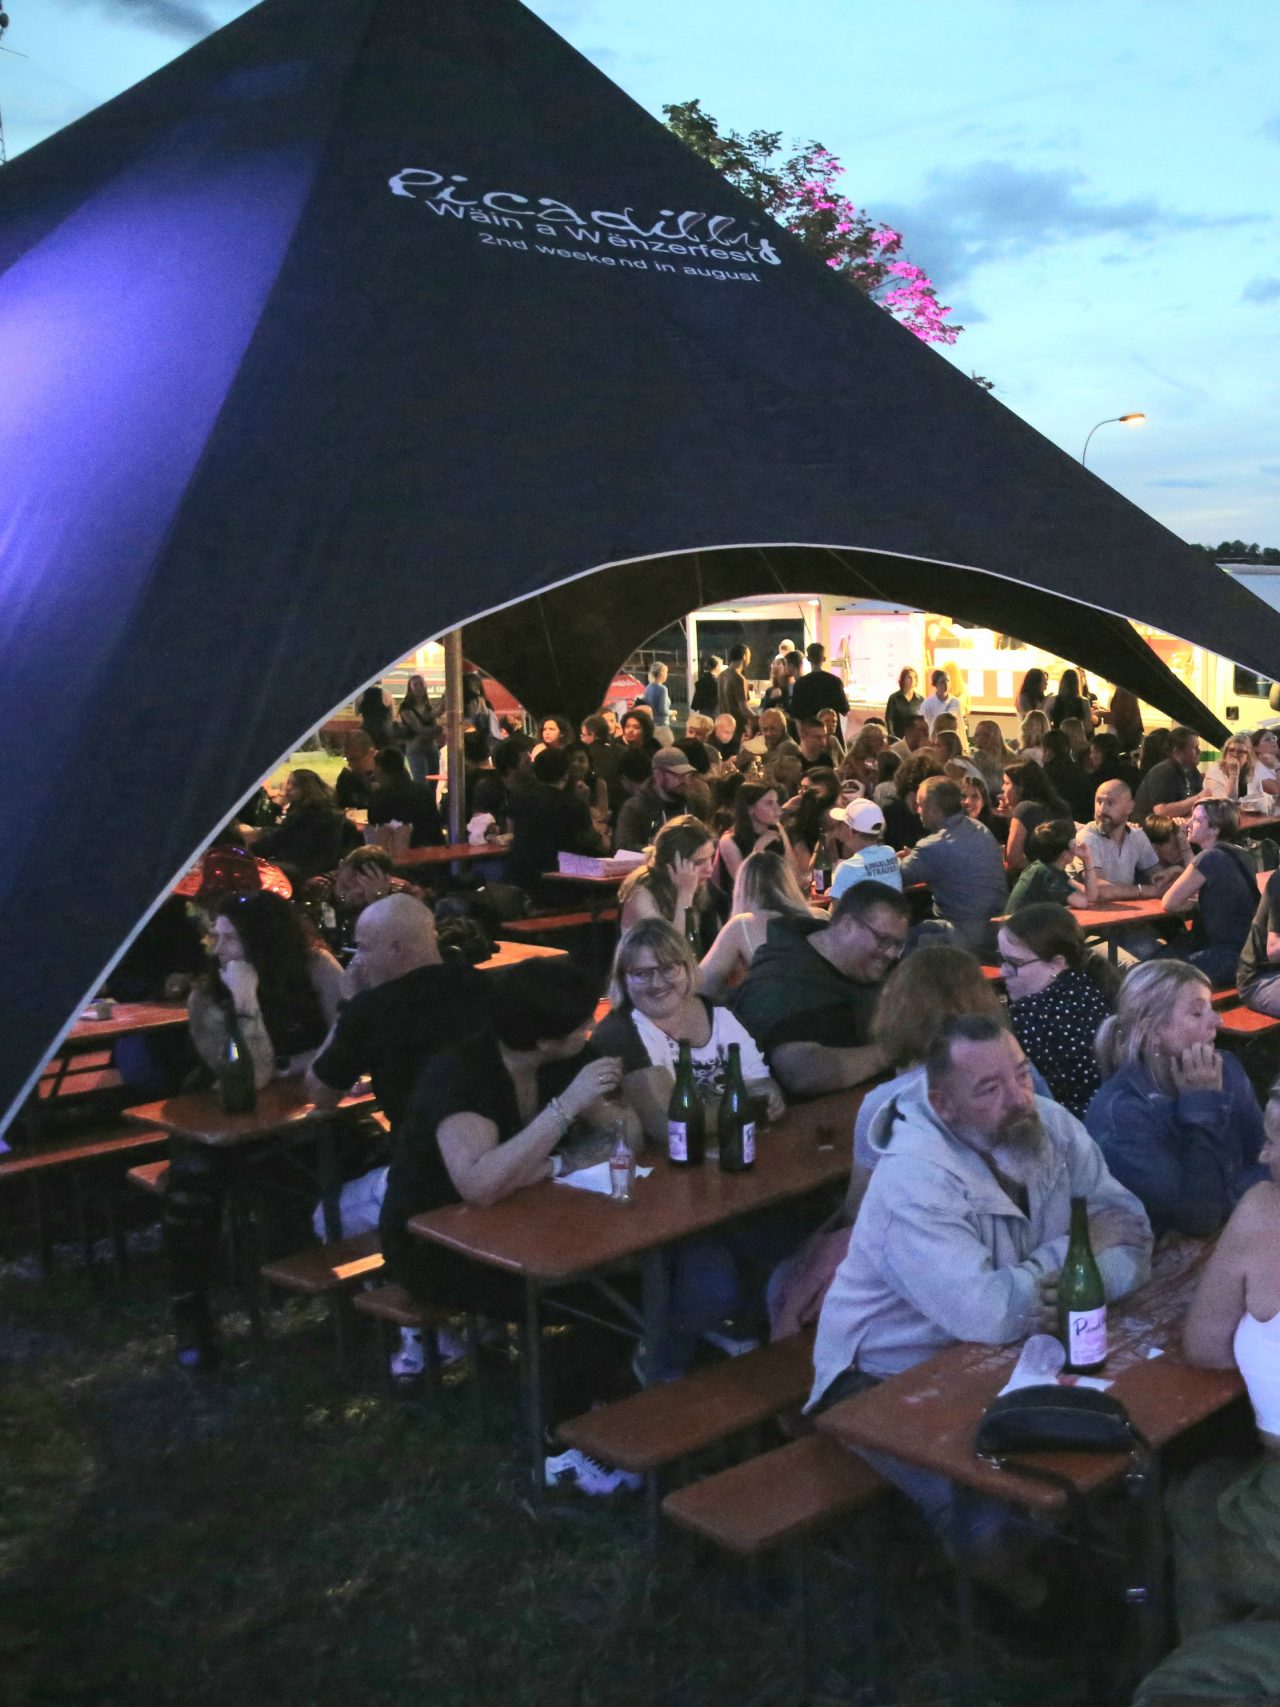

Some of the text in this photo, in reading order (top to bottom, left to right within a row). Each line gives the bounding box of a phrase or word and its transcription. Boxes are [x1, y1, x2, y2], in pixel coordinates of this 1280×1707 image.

[388, 168, 782, 265] Picadilly
[424, 200, 523, 229] Wäin
[536, 223, 557, 236] a
[479, 233, 761, 282] 2nd weekend in august
